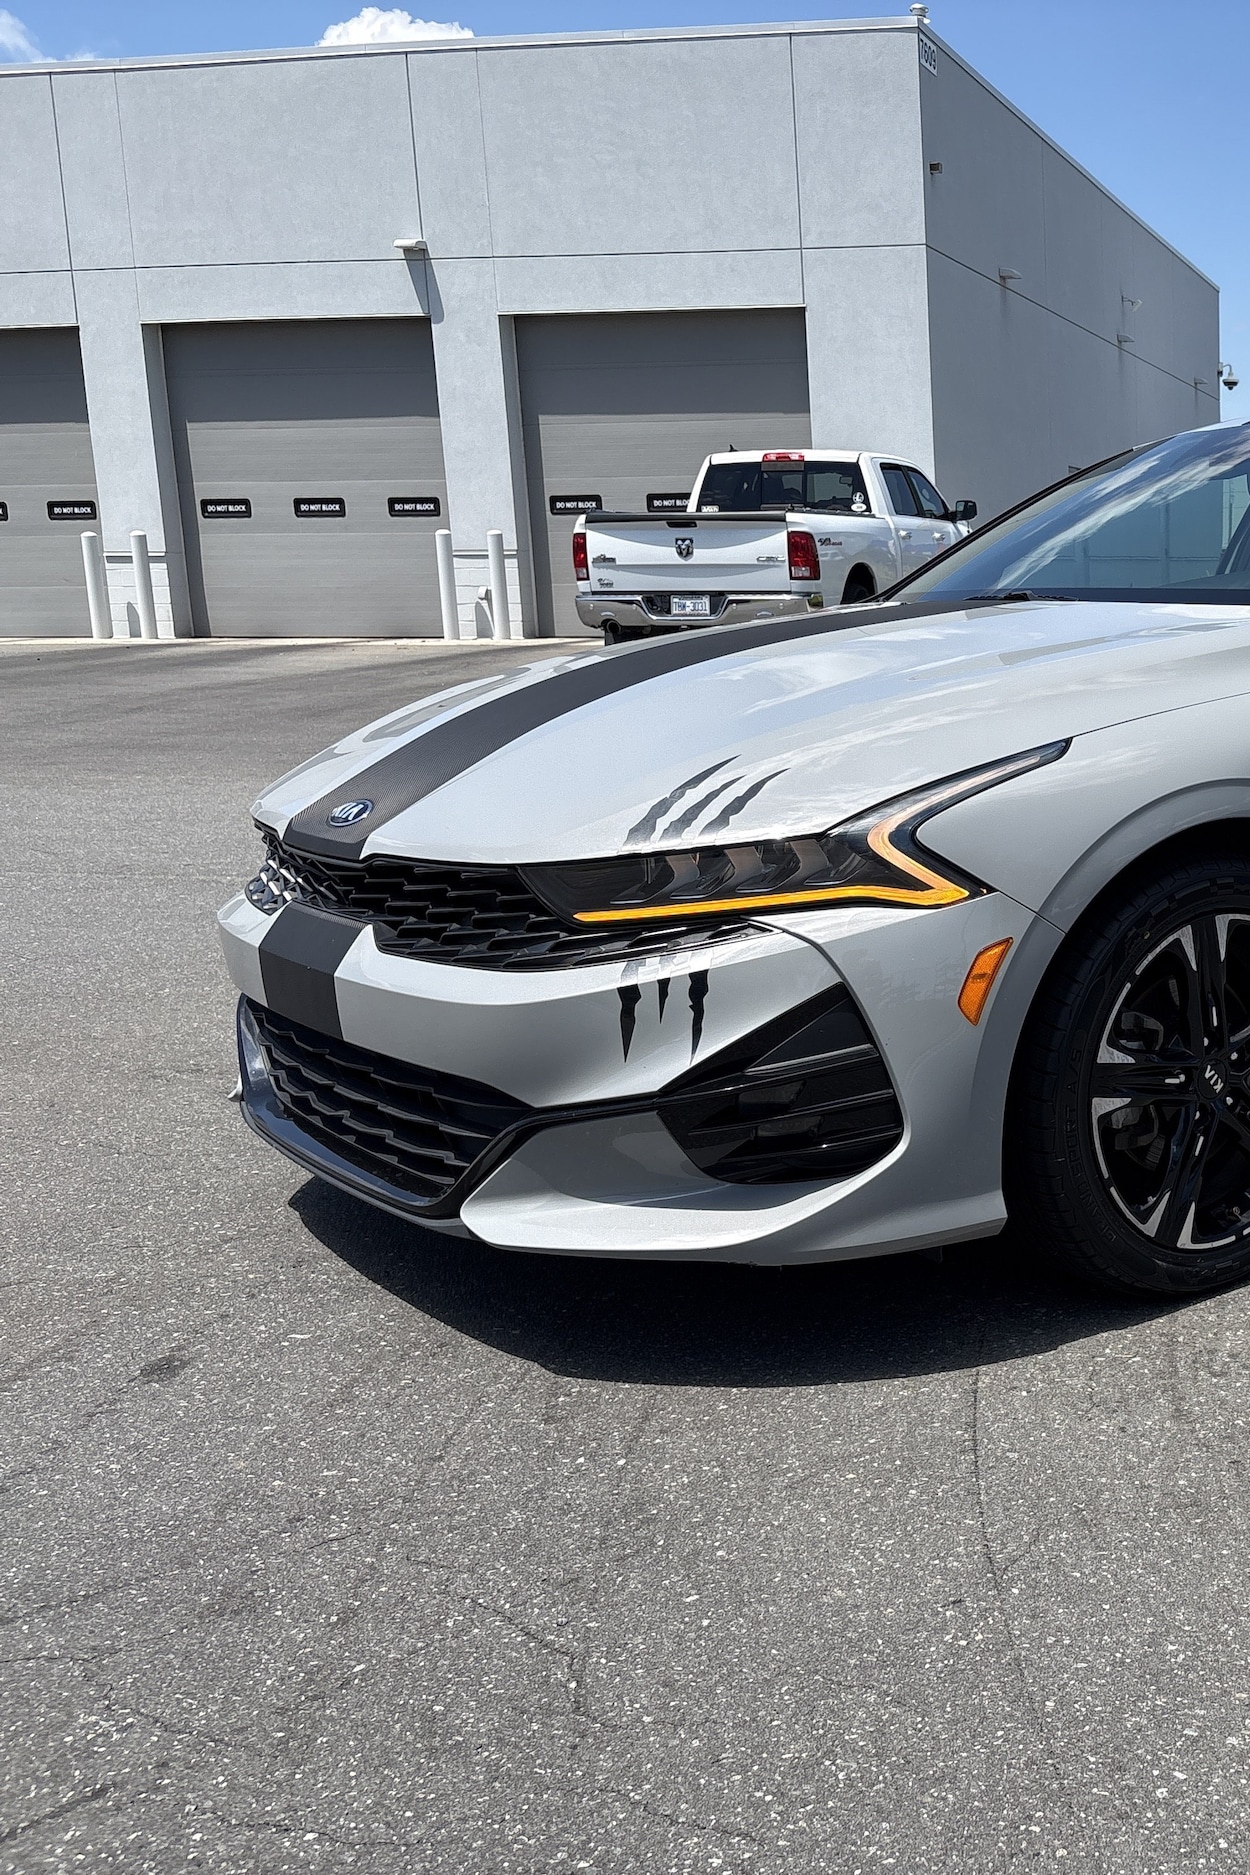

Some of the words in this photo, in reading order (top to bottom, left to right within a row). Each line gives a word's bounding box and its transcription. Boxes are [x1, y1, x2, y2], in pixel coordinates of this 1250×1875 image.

[394, 503, 403, 511] DO
[403, 503, 415, 511] NOT
[416, 503, 435, 511] BLOCK
[556, 501, 565, 509] DO
[565, 501, 577, 509] NOT
[578, 501, 597, 509] BLOCK
[53, 506, 62, 514] DO
[62, 506, 73, 514] NOT
[74, 506, 91, 514] BLOCK
[1204, 1064, 1224, 1094] KIA
